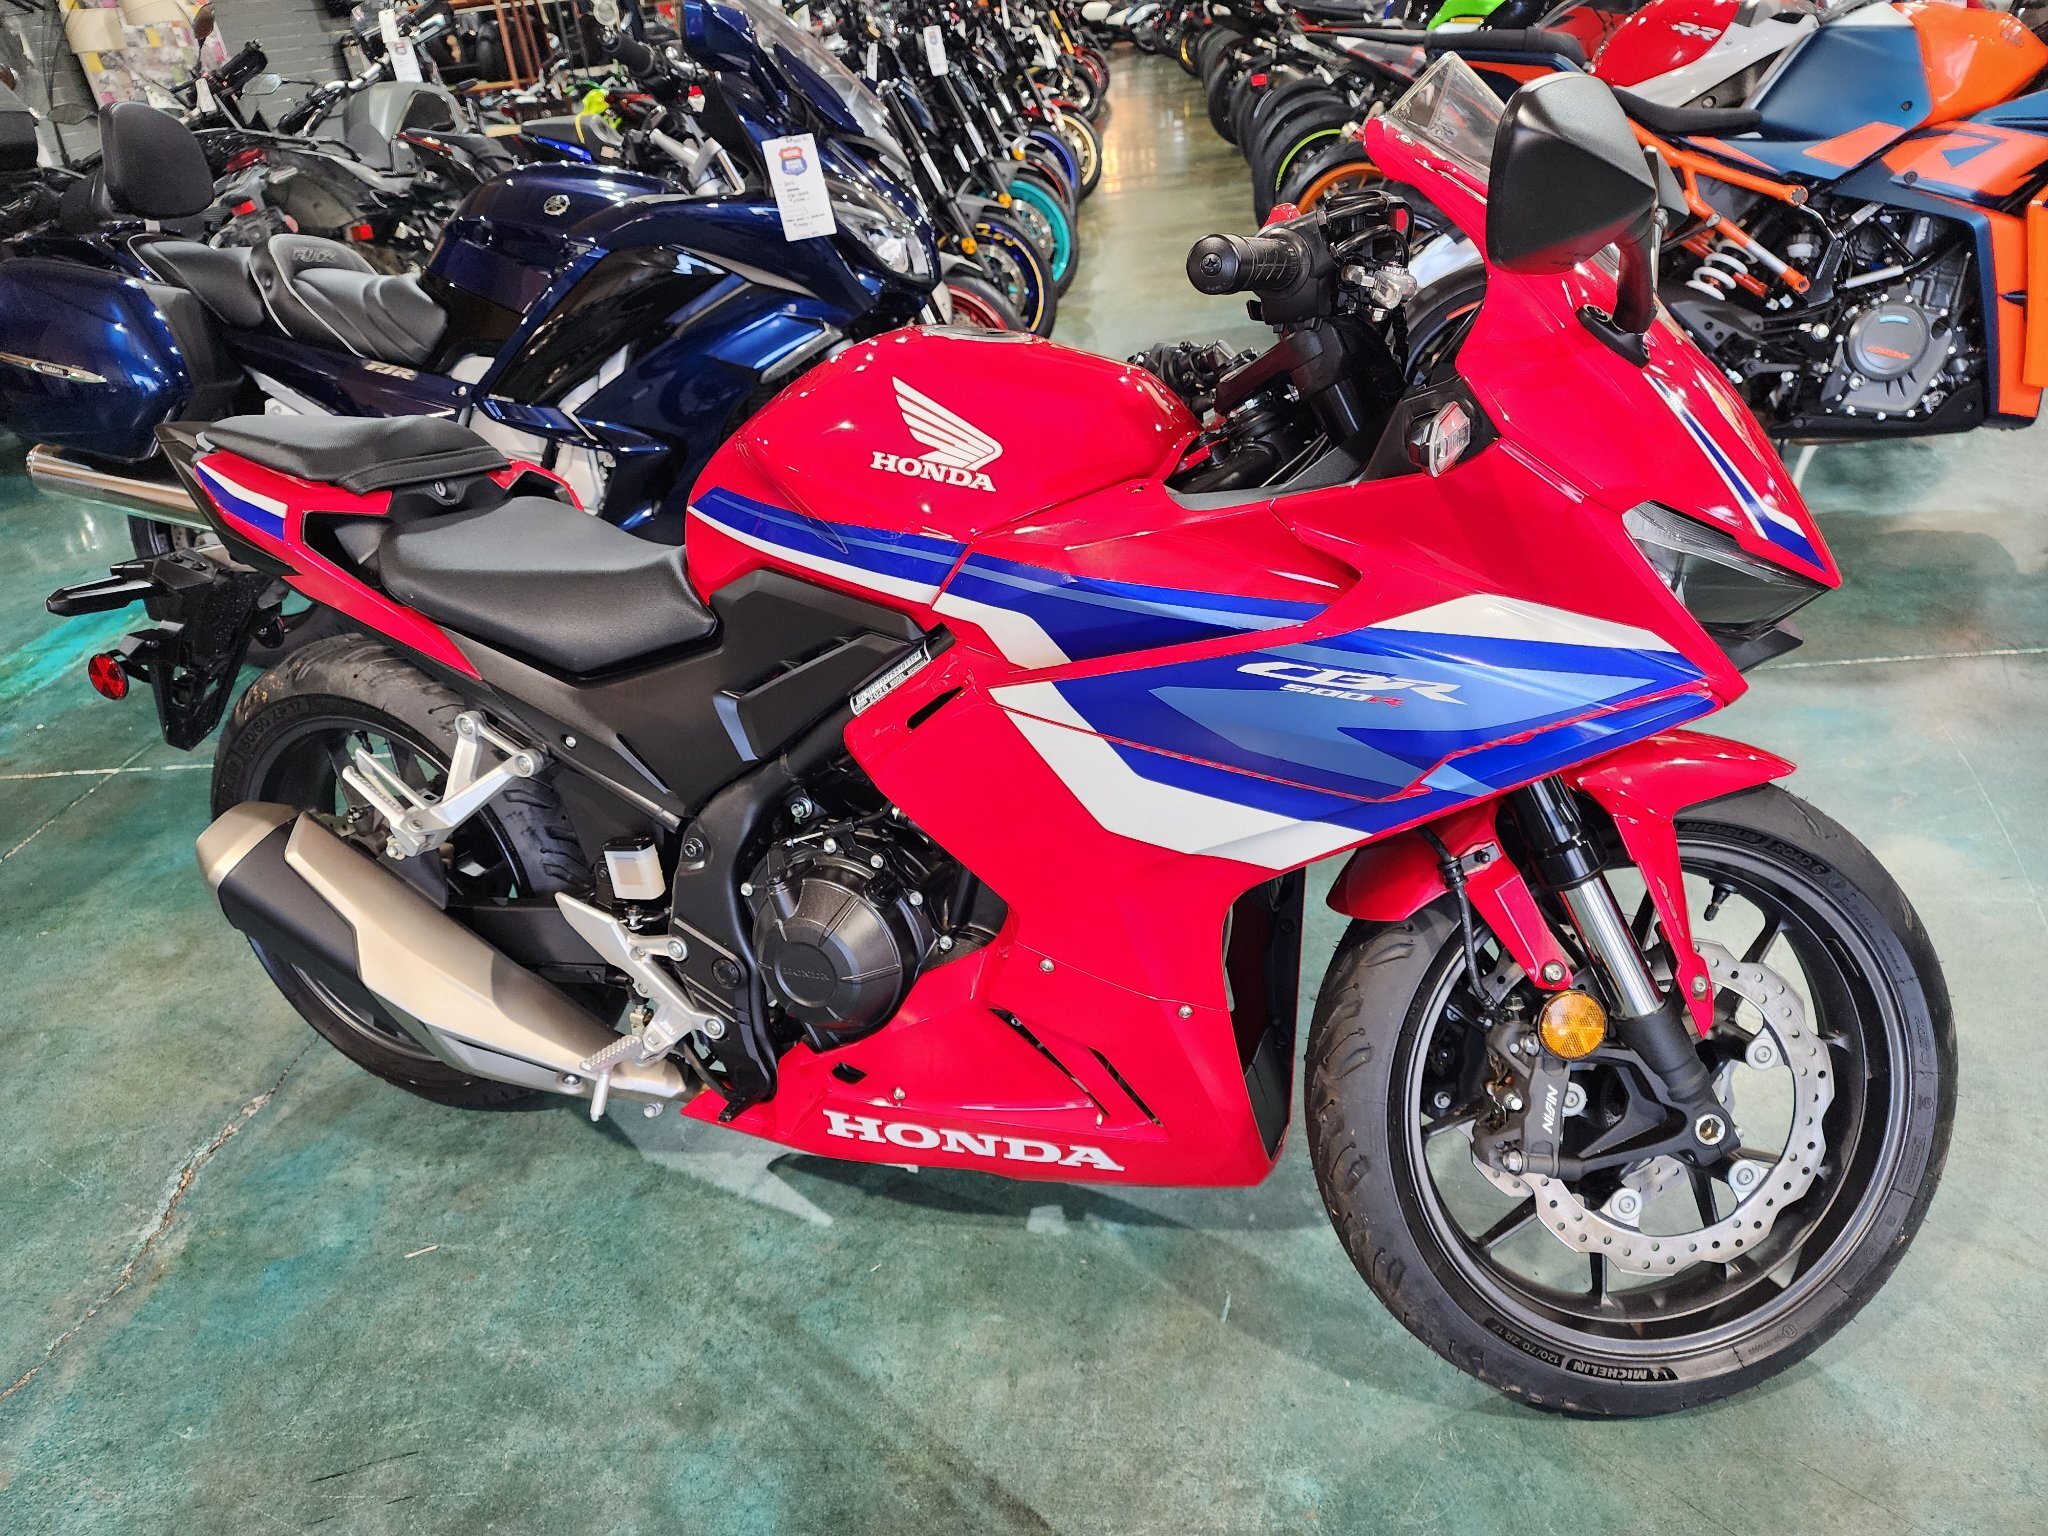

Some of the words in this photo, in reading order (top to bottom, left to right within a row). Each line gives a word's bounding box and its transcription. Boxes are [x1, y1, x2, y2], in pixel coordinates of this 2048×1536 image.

[870, 451, 997, 492] HONDA
[1236, 661, 1468, 705] CBR
[1279, 683, 1408, 708] 500R
[822, 1109, 1125, 1172] HONDA
[1492, 1325, 1504, 1335] 17
[1505, 1331, 1521, 1345] ZR
[1522, 1342, 1559, 1364] 120/70
[1573, 1360, 1648, 1380] MICHELIN
